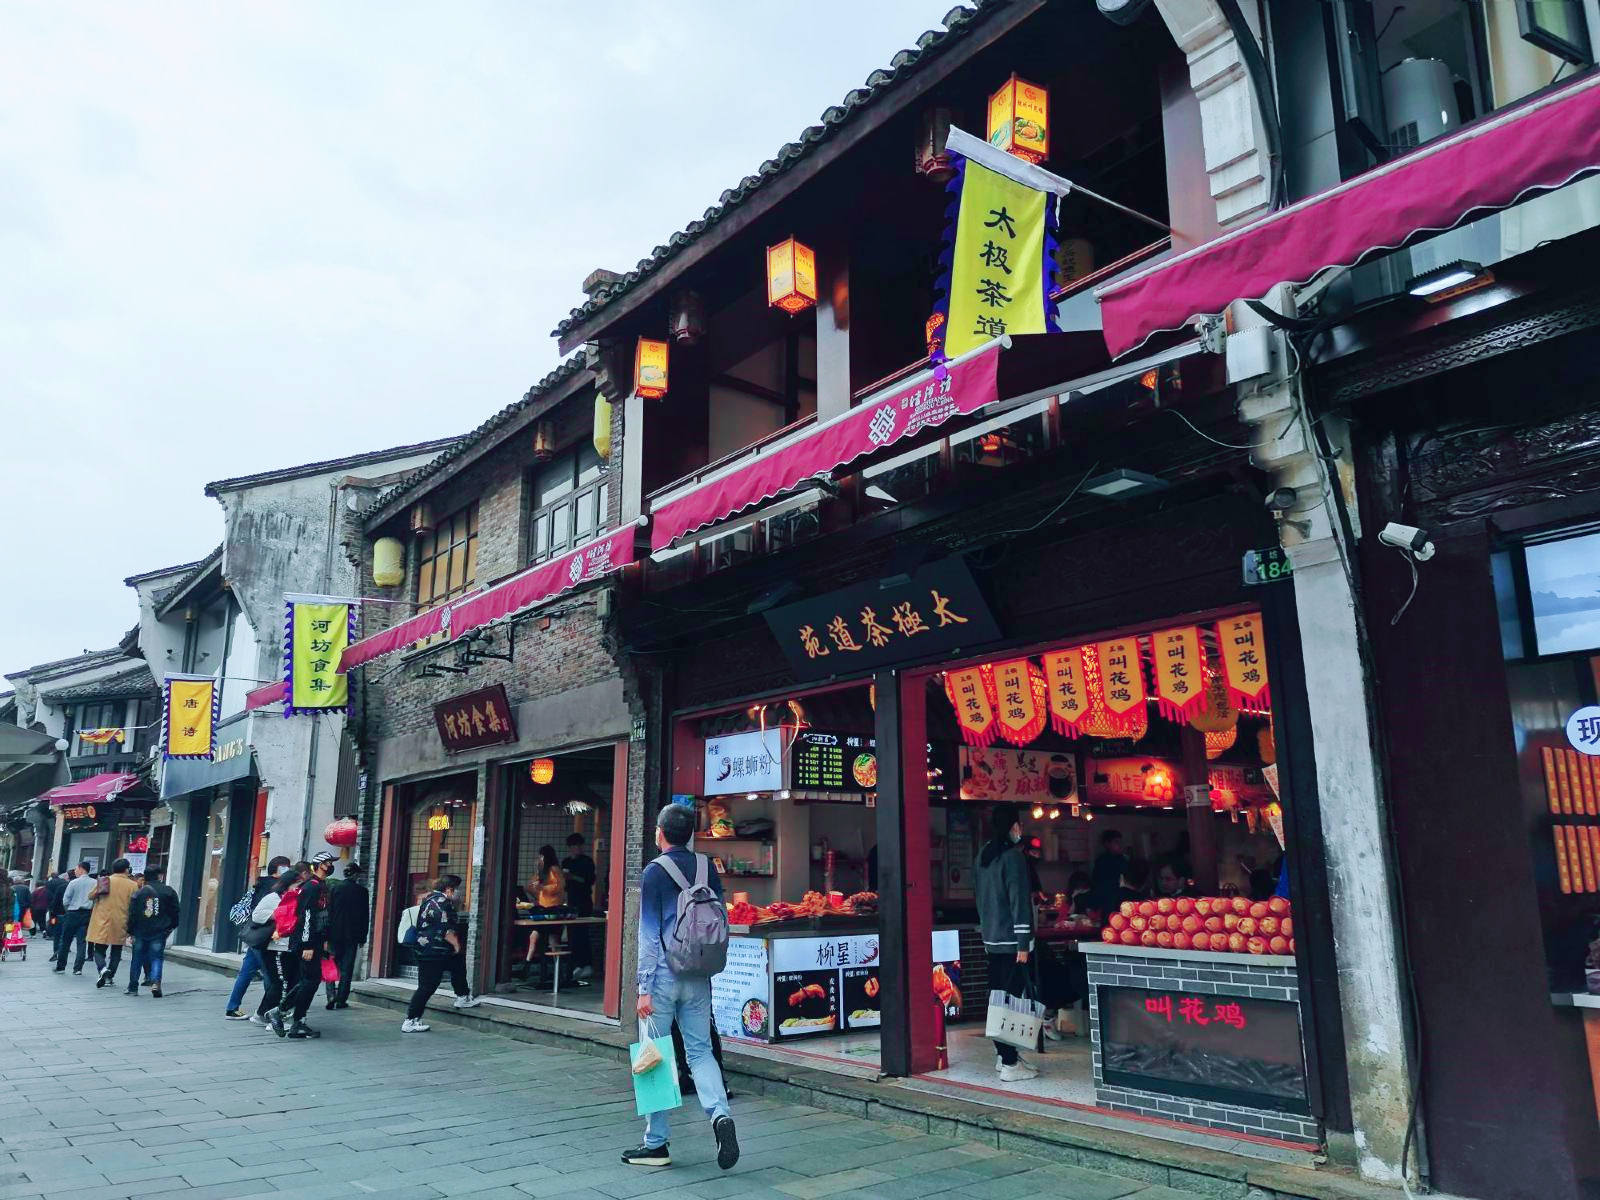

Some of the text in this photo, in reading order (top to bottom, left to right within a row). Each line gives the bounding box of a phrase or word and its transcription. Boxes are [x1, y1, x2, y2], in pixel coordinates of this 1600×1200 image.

[973, 206, 1017, 338] 太极茶道
[1256, 557, 1294, 580] 184
[310, 620, 332, 691] 河坊食集
[1109, 655, 1131, 701] 叫花鸡
[1168, 645, 1189, 694] 叫花鸡
[1234, 631, 1261, 683] 叫花鸡
[962, 683, 985, 722] 叫花鸡
[1005, 677, 1026, 719] 叫花鸡
[1057, 666, 1078, 711] 叫花鸡
[816, 942, 850, 967] 柳星
[1145, 995, 1246, 1030] 叫花鸡
